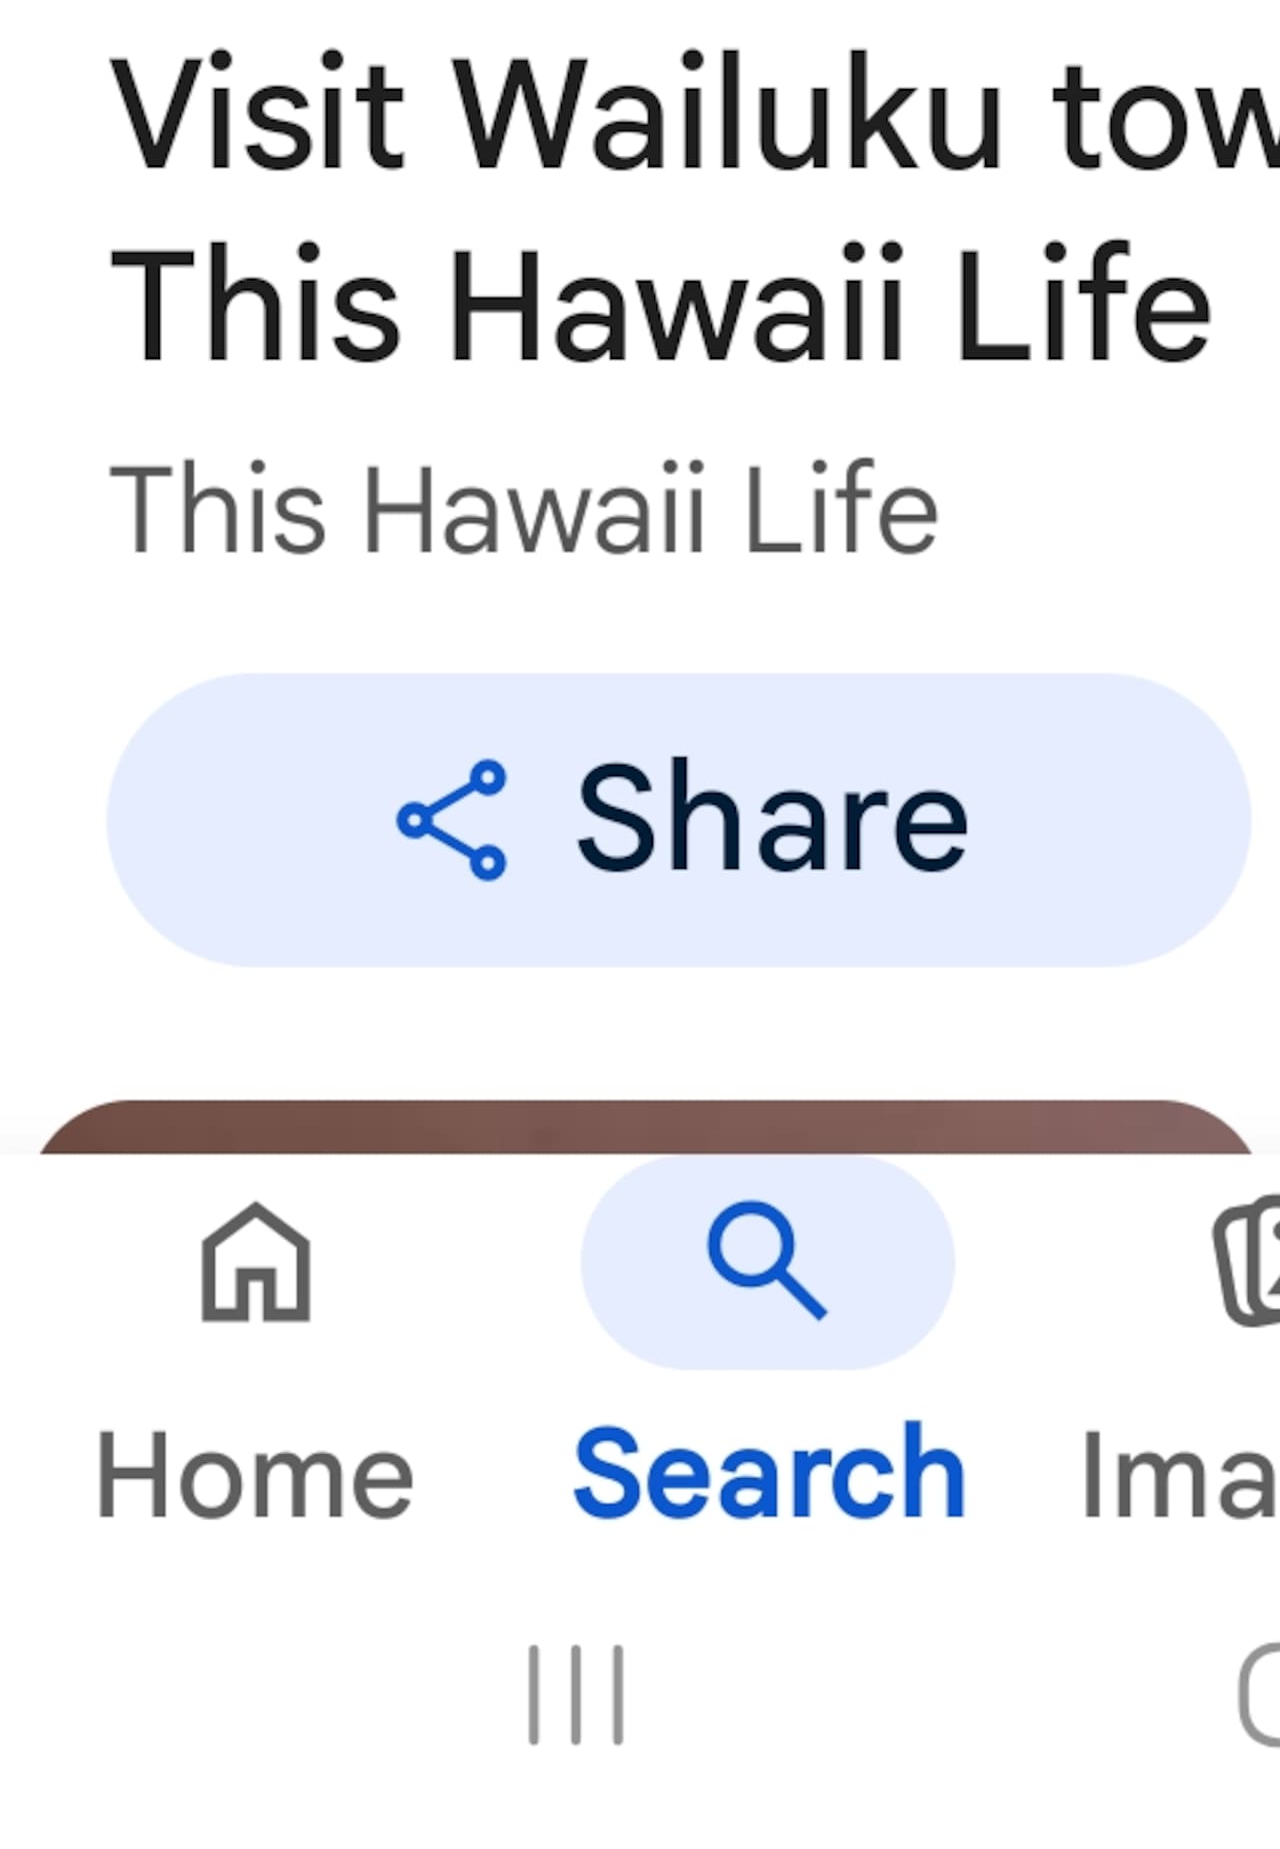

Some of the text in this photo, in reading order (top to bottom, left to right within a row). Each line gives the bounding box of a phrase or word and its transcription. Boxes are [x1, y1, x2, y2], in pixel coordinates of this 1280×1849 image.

[109, 48, 405, 171] Visit
[451, 48, 1000, 171] Wailuku
[110, 239, 1211, 363] This Hawaii Life
[109, 457, 938, 555] This Hawaii Life
[577, 756, 967, 872] Share
[98, 1431, 415, 1522] Home
[574, 1420, 966, 1522] Search
